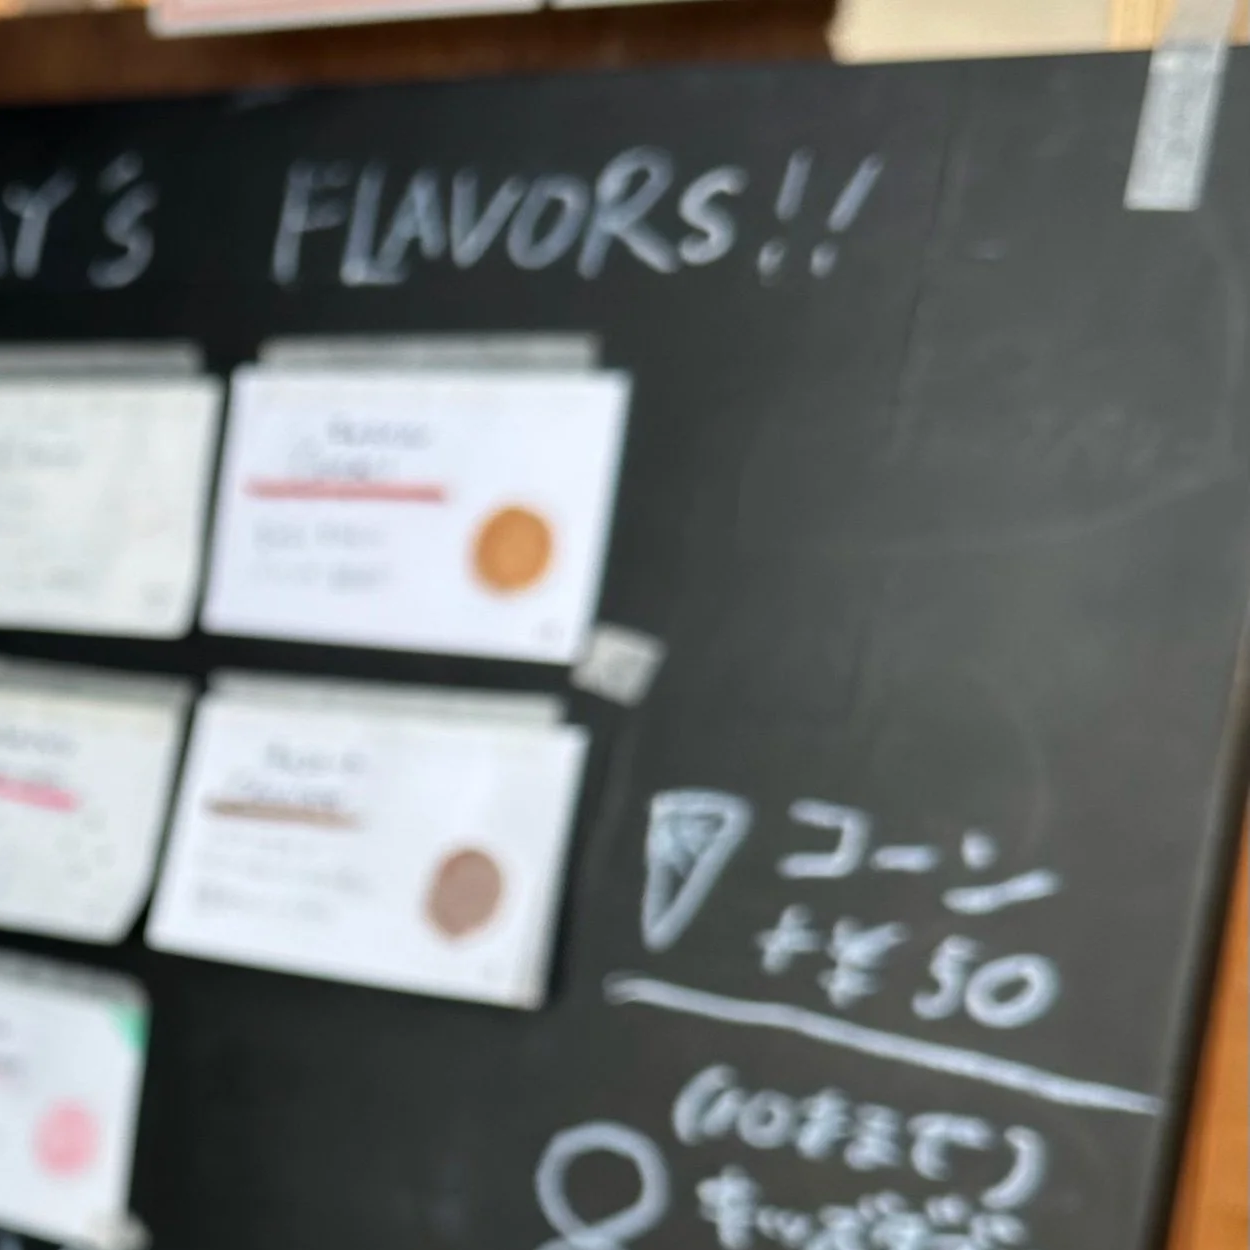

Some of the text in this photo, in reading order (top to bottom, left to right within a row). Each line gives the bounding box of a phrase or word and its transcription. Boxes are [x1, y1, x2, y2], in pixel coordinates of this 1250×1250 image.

[272, 145, 883, 284] FLAVORS!!
[776, 798, 1061, 914] コーン
